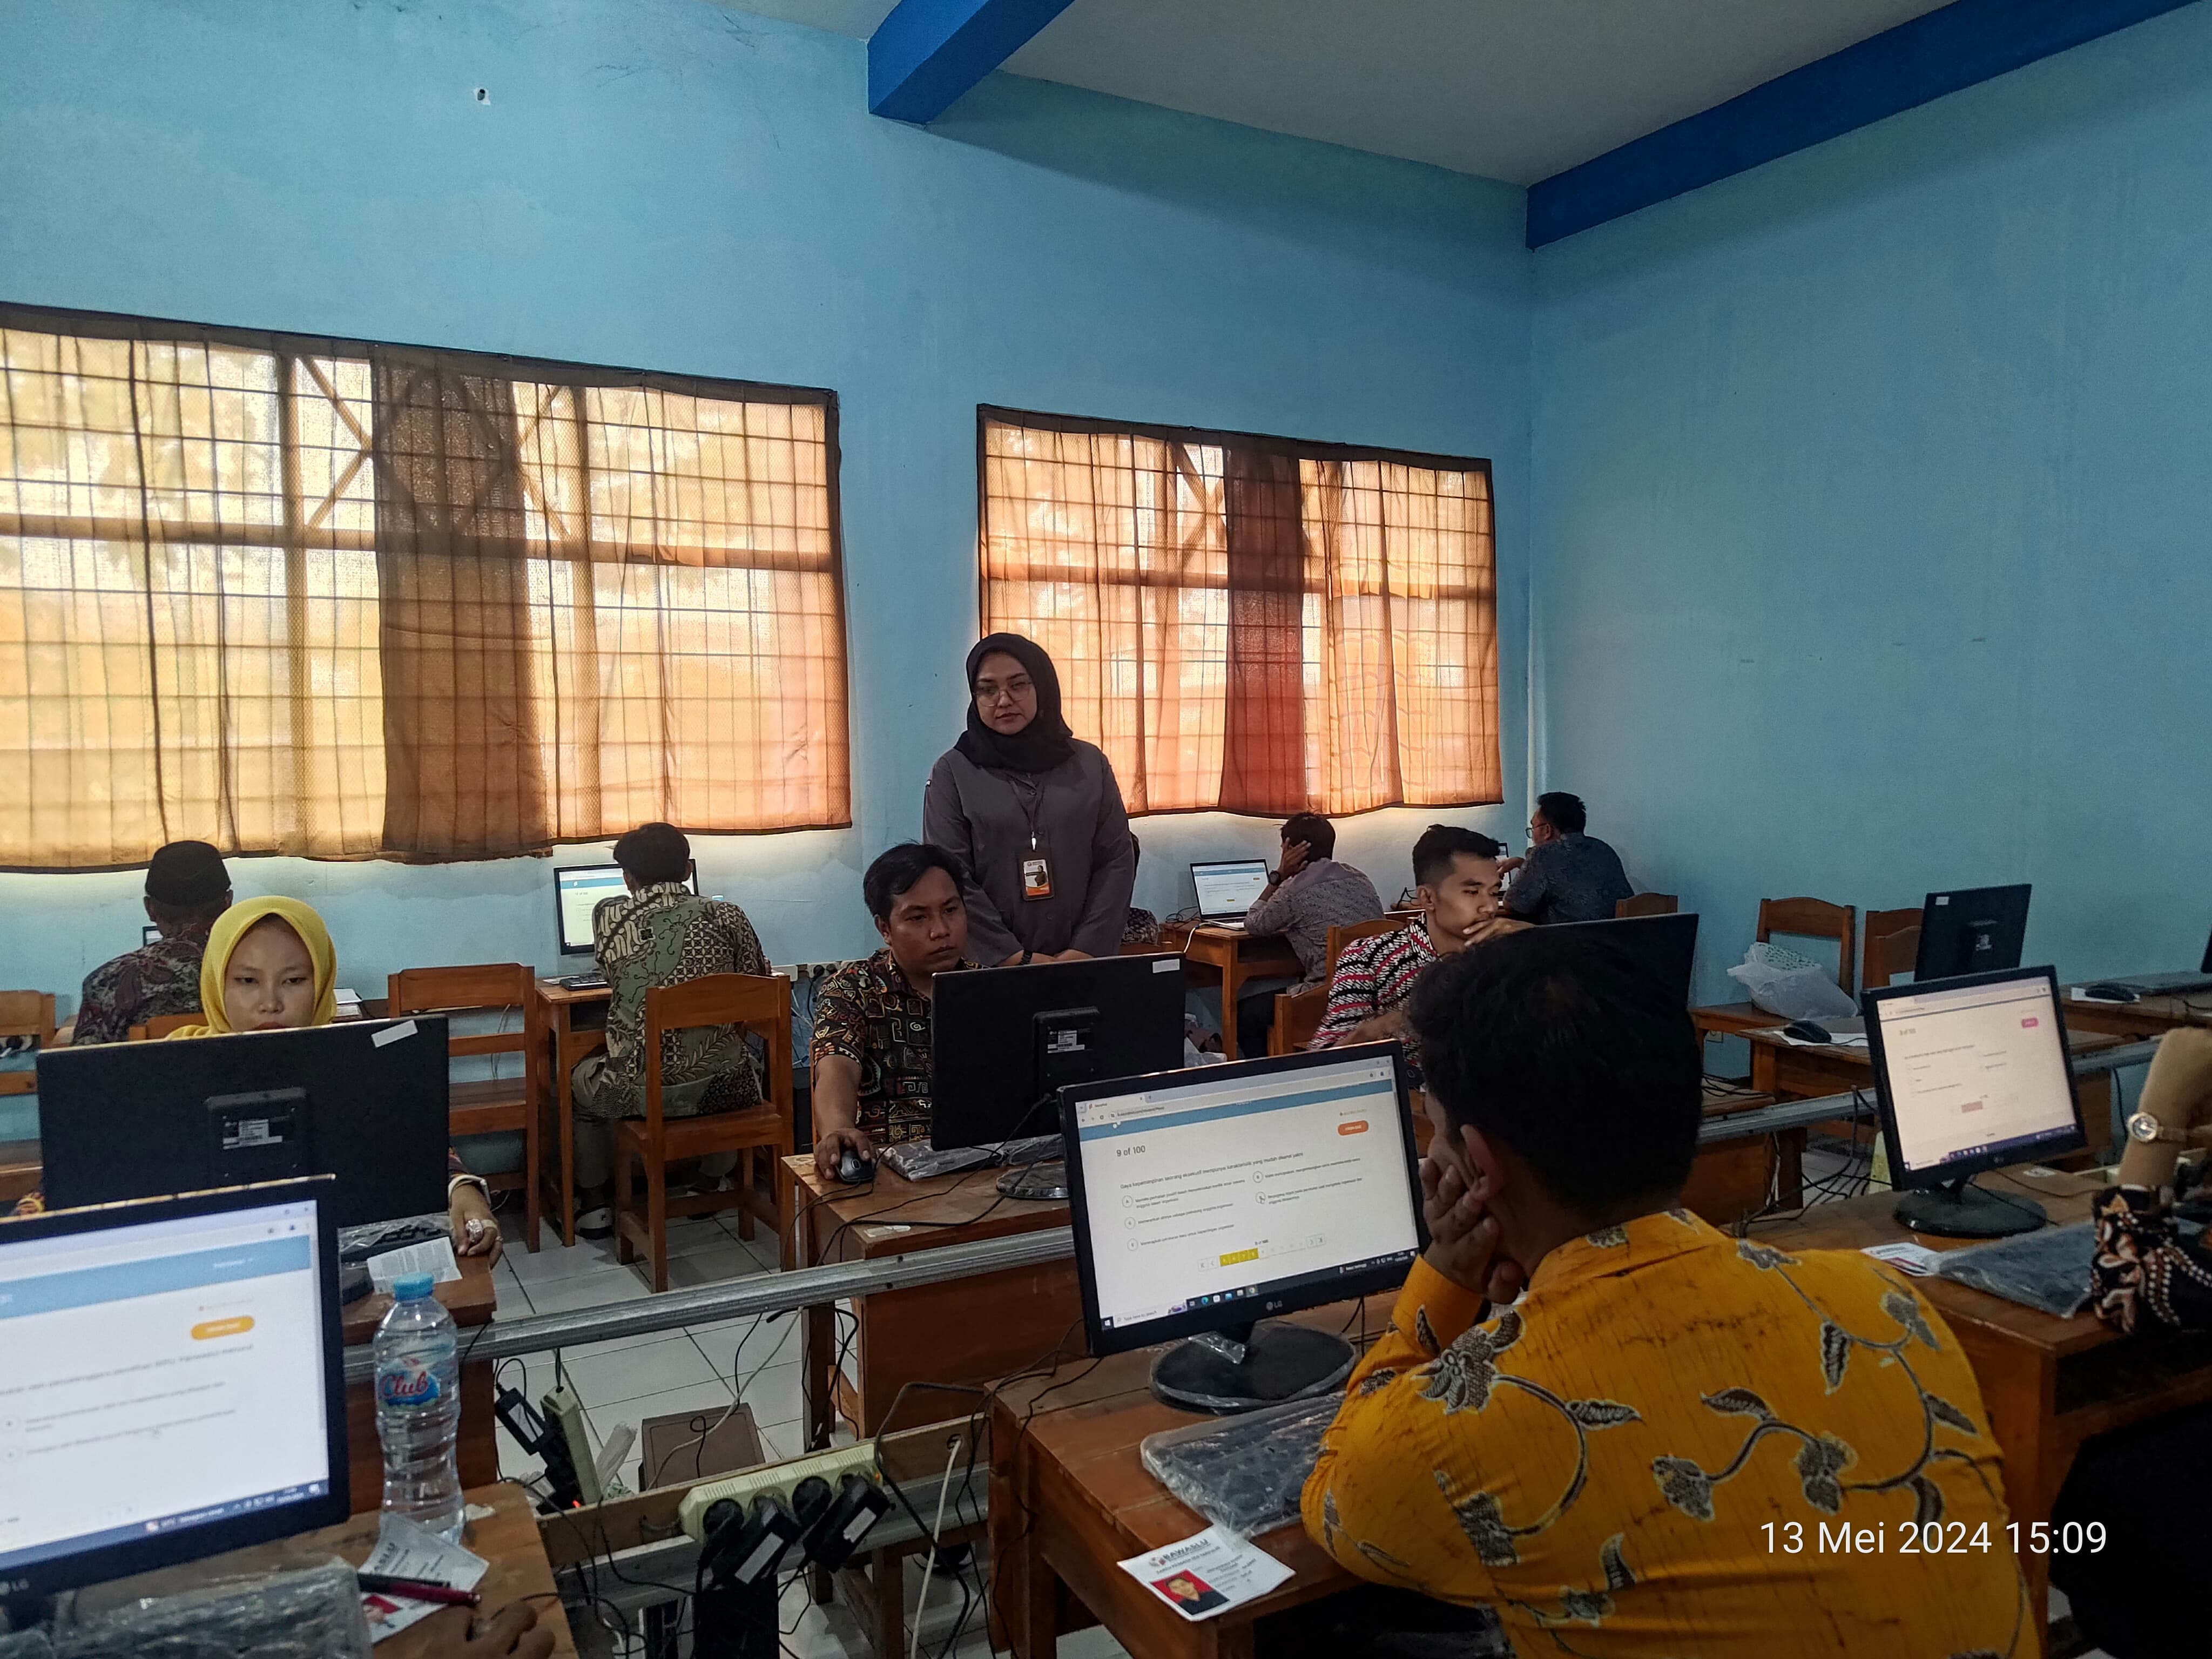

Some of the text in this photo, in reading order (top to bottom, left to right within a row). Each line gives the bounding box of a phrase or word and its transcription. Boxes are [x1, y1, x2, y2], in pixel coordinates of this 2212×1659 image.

[1123, 1148, 1131, 1156] of
[1133, 1145, 1146, 1155] 100
[380, 1371, 428, 1400] Club
[1163, 1539, 1209, 1560] BAWASLU
